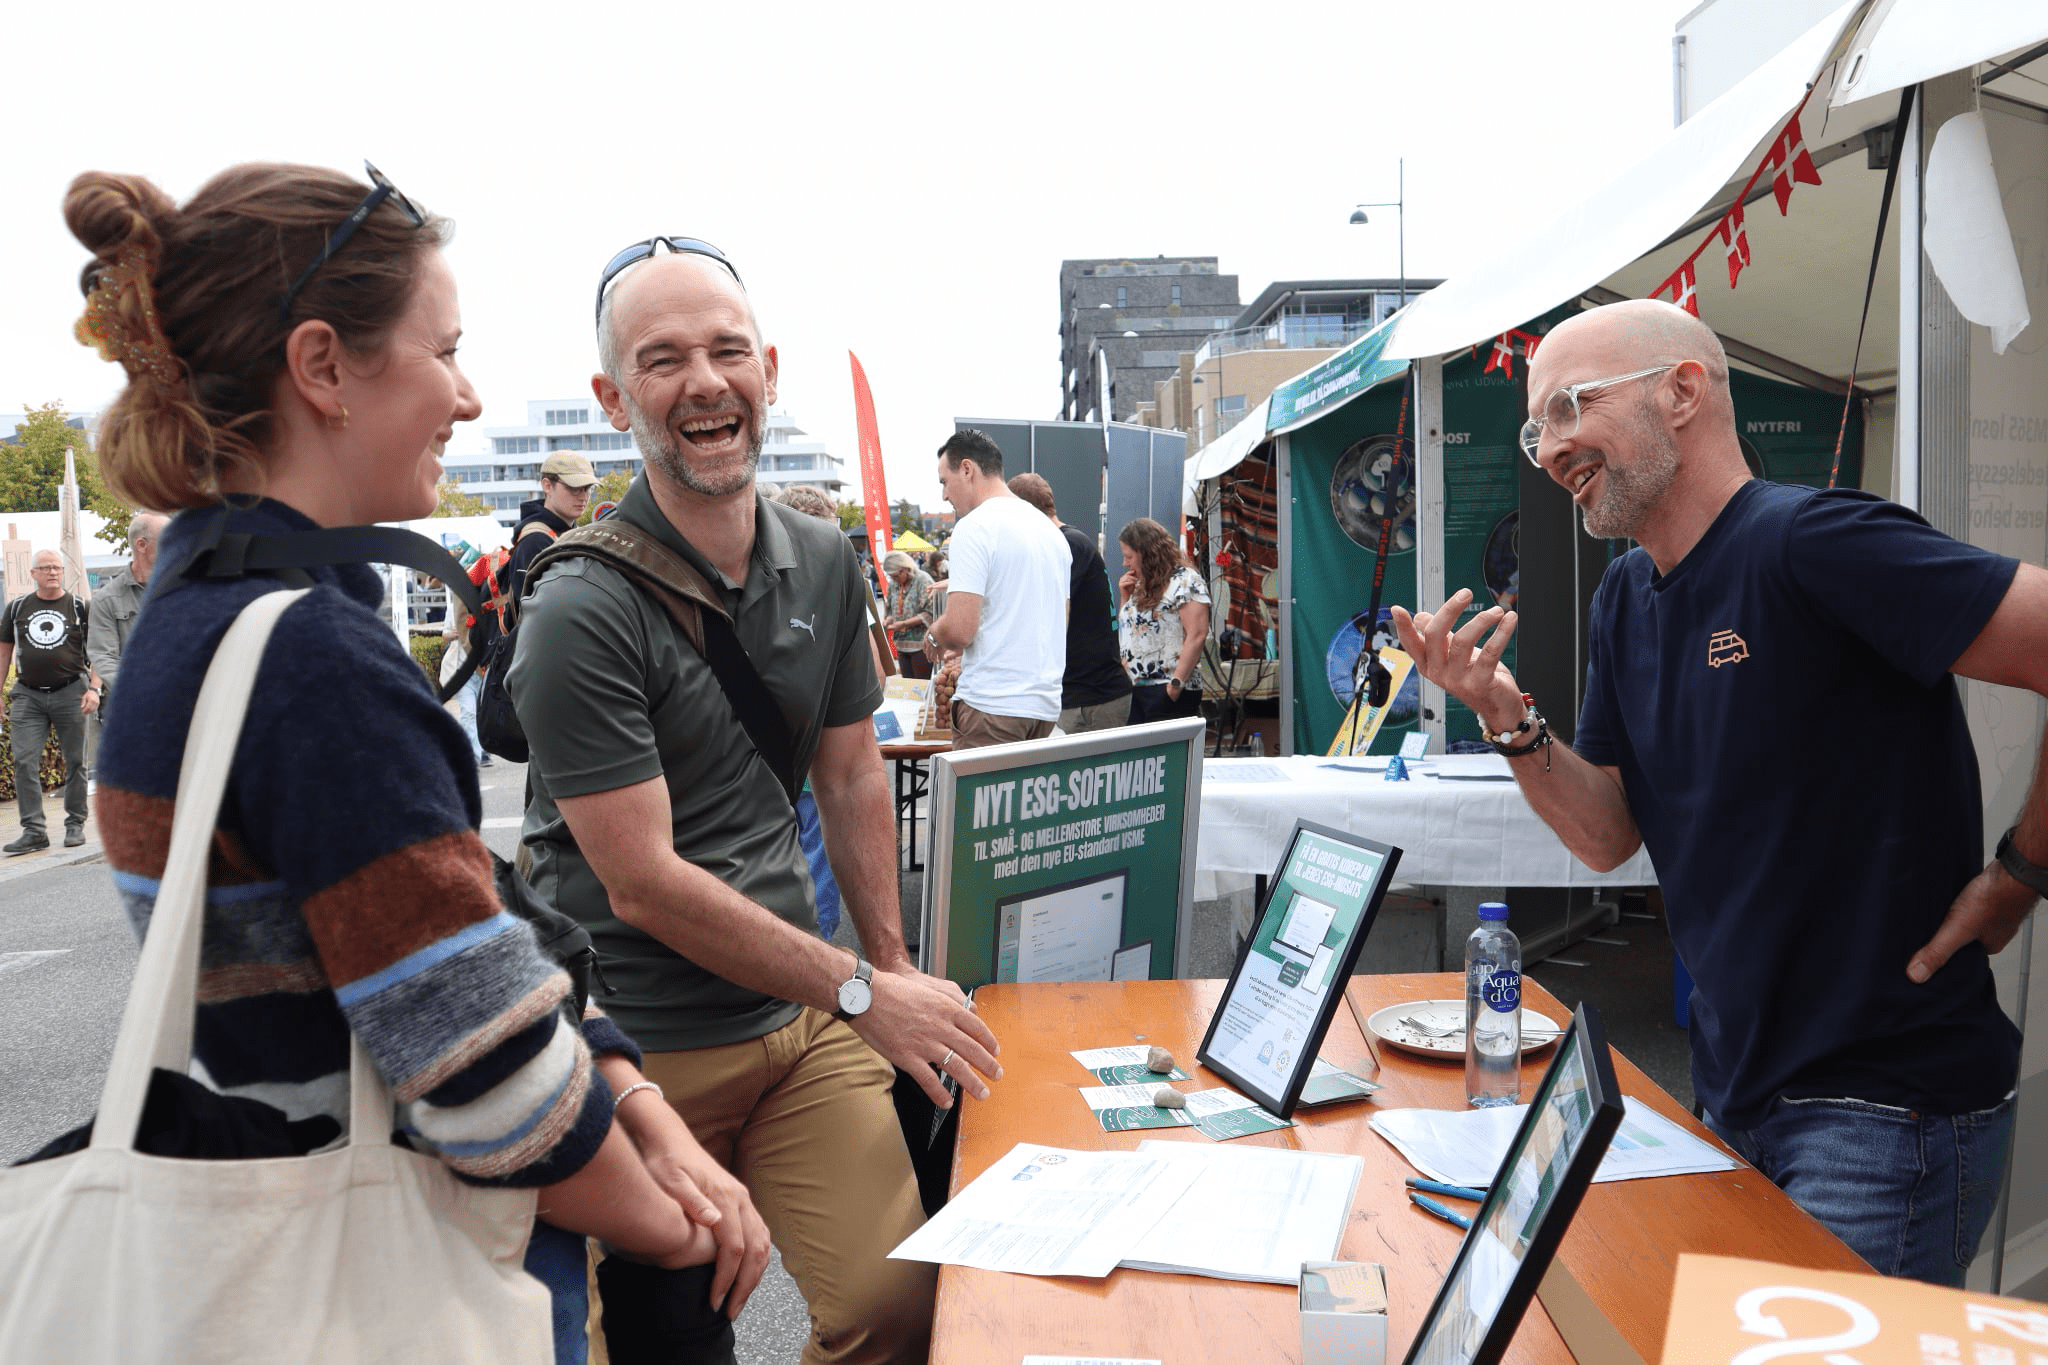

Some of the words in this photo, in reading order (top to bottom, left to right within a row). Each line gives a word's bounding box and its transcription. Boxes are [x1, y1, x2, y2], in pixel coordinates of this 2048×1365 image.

[1443, 432, 1471, 444] OST
[1746, 421, 1801, 432] NYTFRI
[973, 781, 1015, 829] NYT
[1021, 755, 1166, 820] ESG-SOFTWARE
[974, 841, 988, 862] TIL
[990, 828, 1018, 858] SMÅ-
[1020, 832, 1034, 852] OG
[1036, 817, 1102, 848] MELLEMSTORE
[1104, 804, 1166, 833] VIRKSOMHEDER
[993, 857, 1019, 880] med
[1021, 854, 1040, 874] den
[1042, 850, 1061, 870] nye
[1063, 834, 1120, 863] EU-standard
[1121, 828, 1145, 850] VSME
[1485, 975, 1520, 991] Aqua
